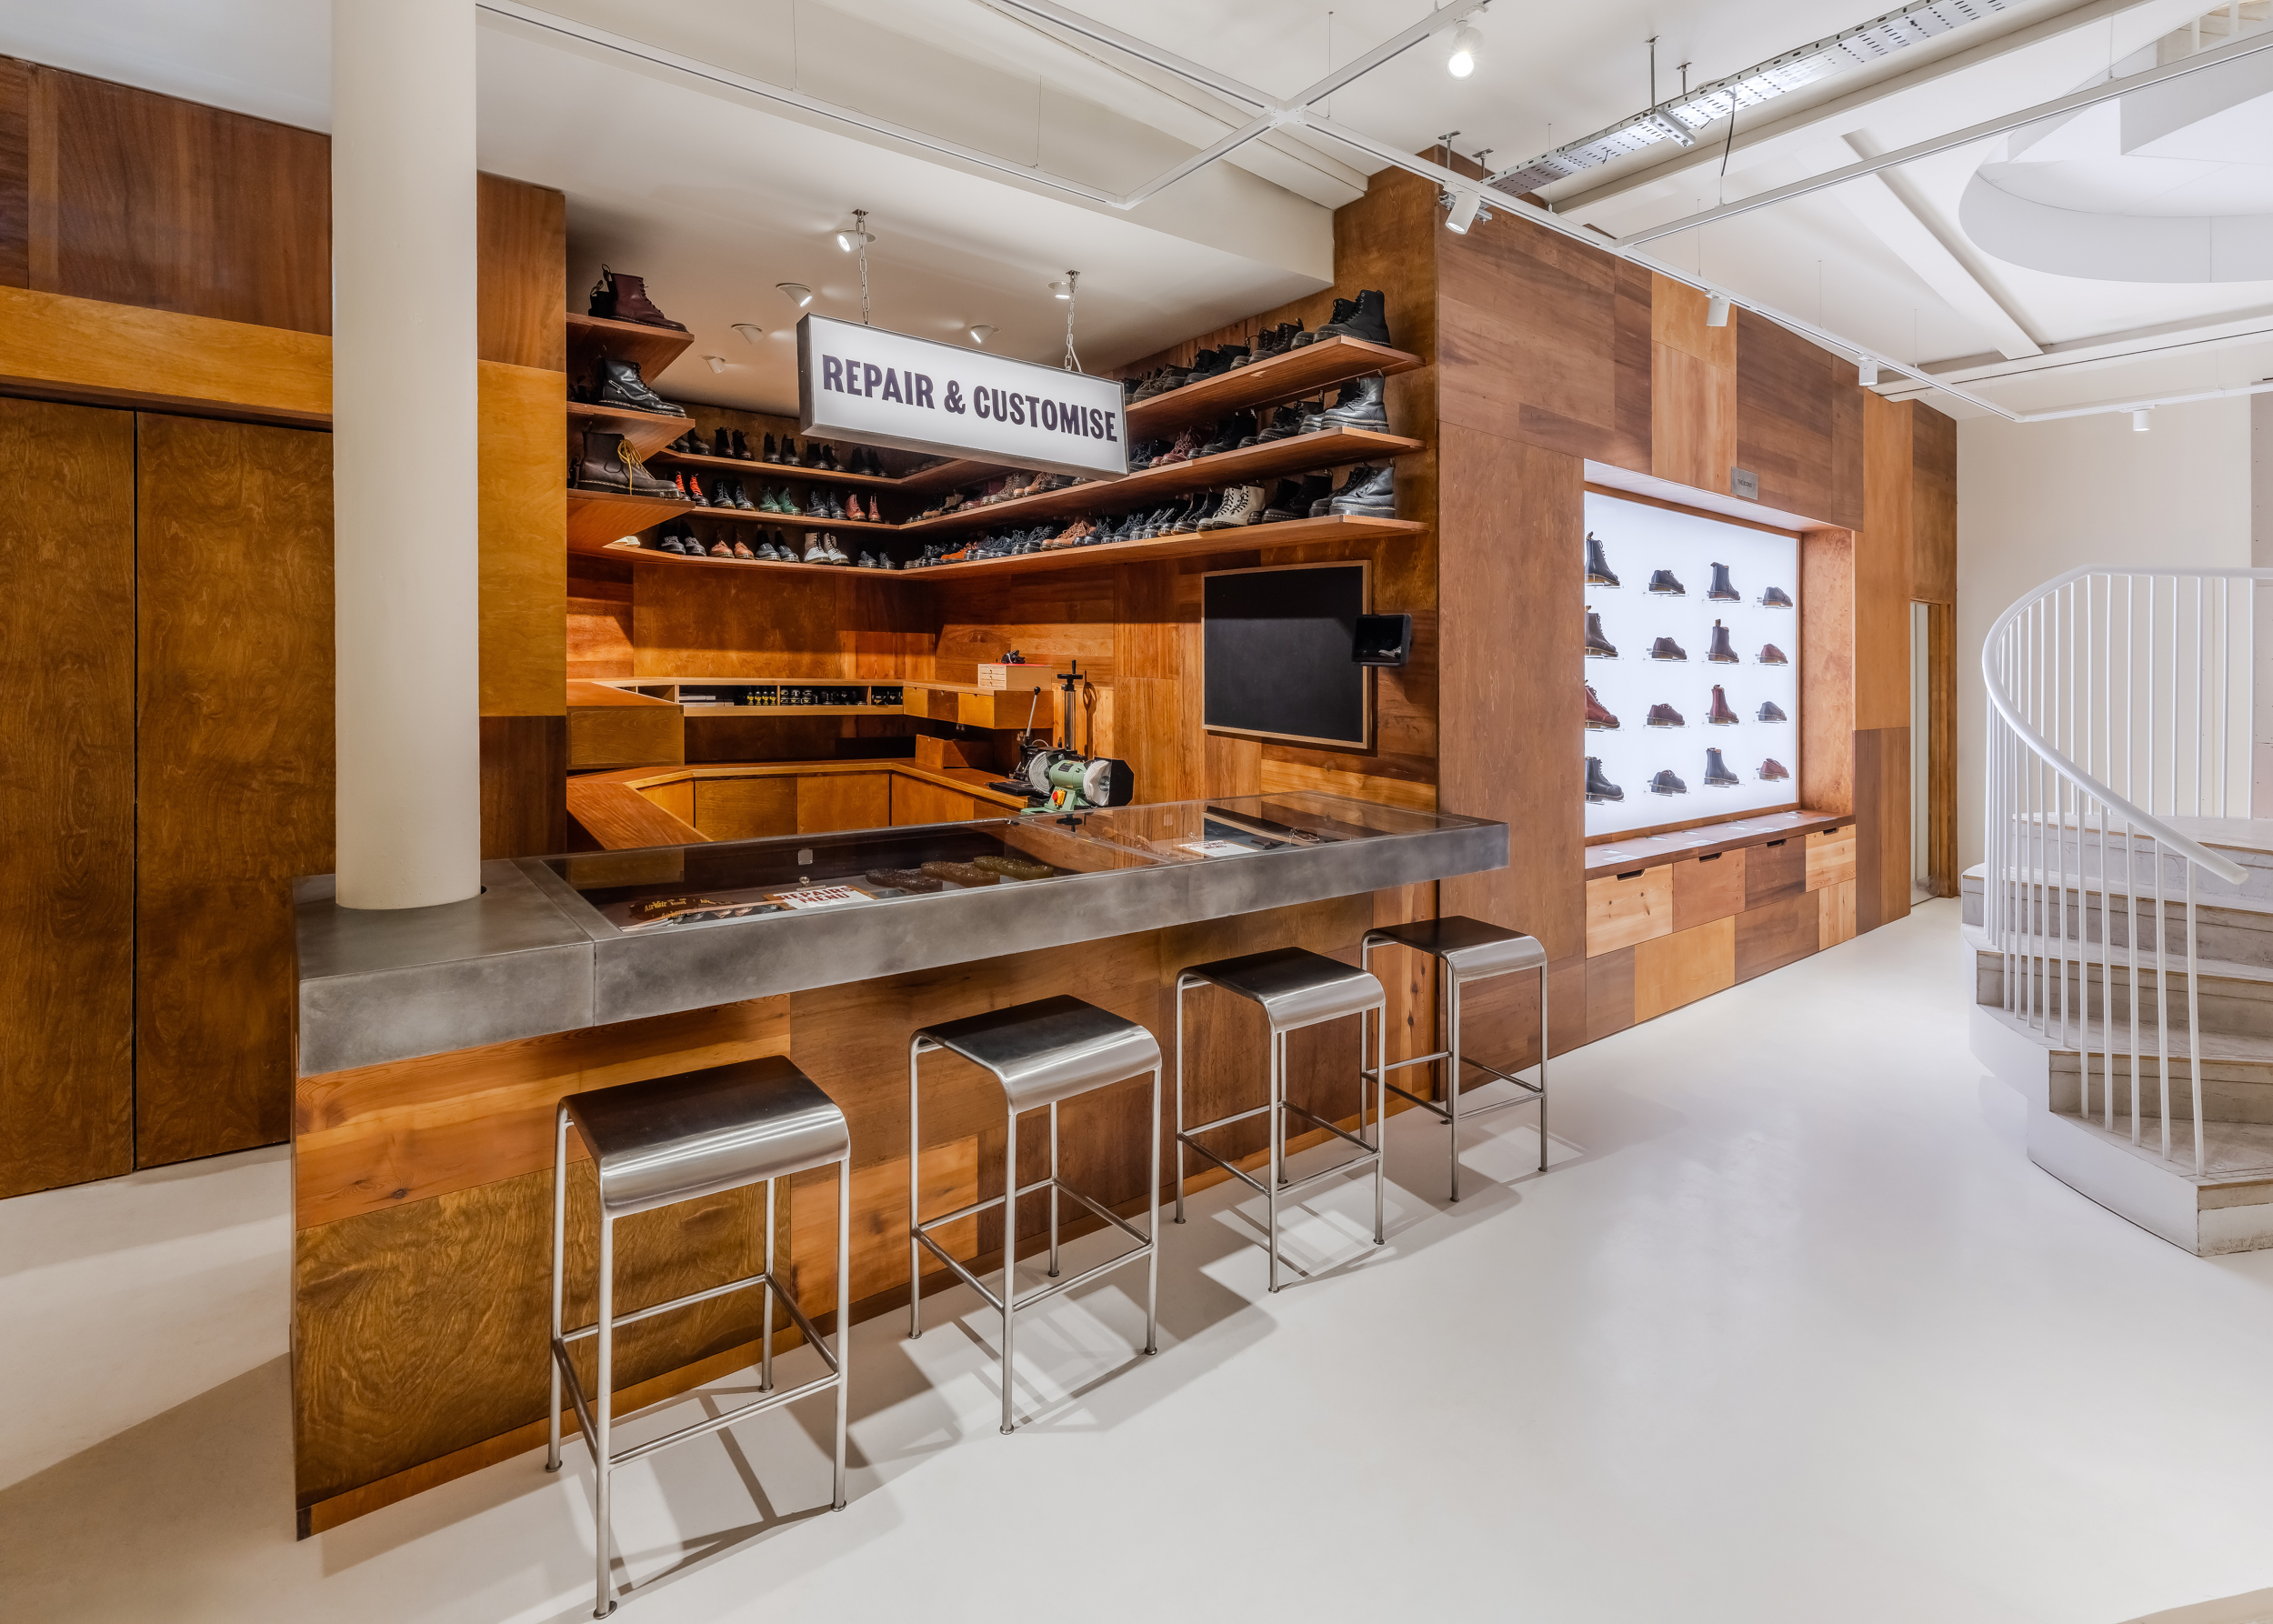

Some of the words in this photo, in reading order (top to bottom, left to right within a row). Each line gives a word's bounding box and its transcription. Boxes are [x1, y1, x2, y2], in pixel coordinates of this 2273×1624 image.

[822, 354, 936, 409] REPAIR
[944, 379, 966, 415] &
[973, 386, 1117, 442] CUSTOMISE
[779, 887, 853, 900] REPAIRS
[800, 893, 851, 904] MENU
